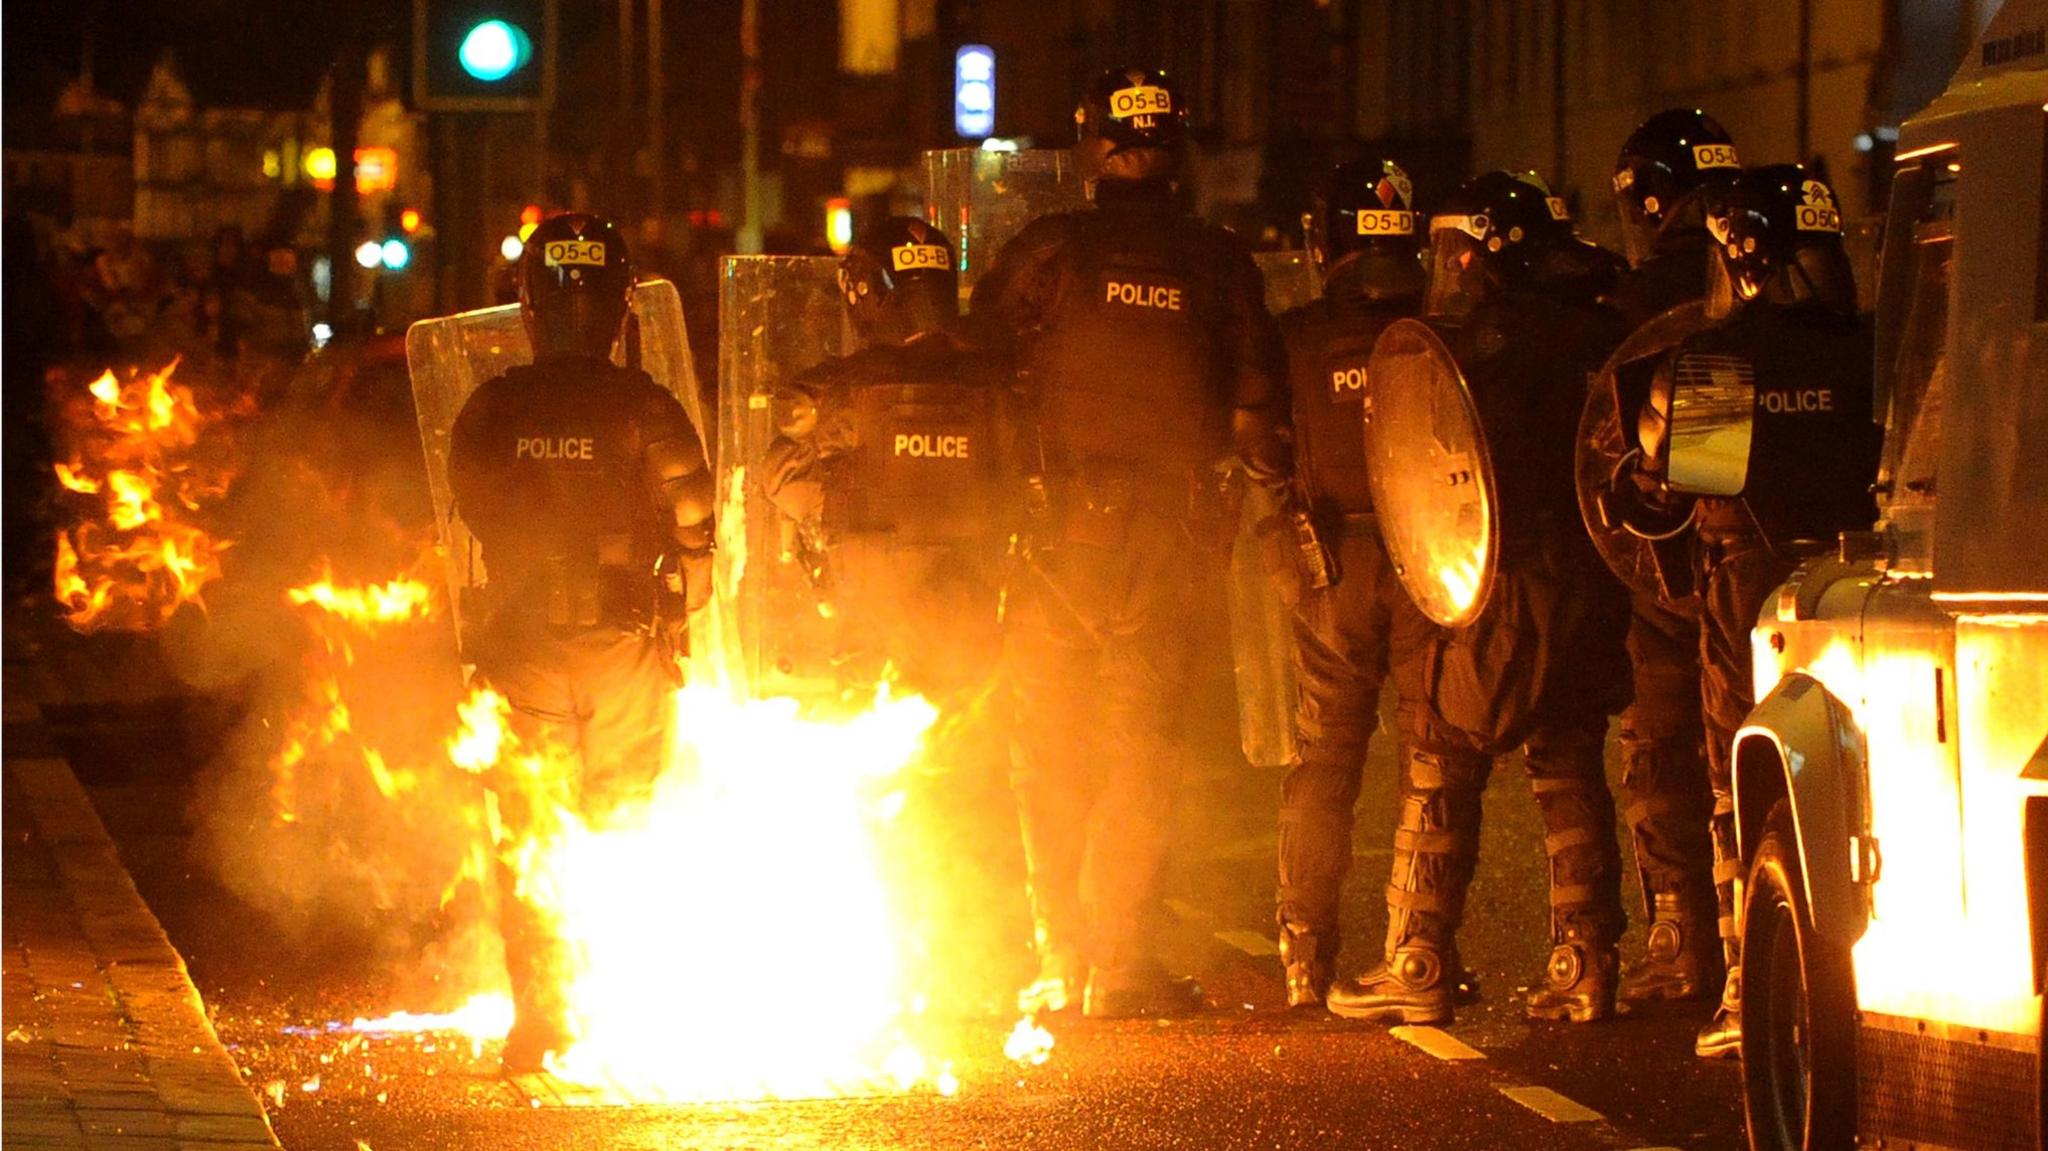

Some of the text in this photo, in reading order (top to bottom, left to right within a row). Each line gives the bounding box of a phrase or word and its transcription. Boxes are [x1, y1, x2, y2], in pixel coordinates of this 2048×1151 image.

[1117, 90, 1170, 111] O5-B
[1362, 212, 1411, 231] O5-D
[550, 243, 602, 262] O5-C
[899, 247, 948, 266] O5-B
[1106, 281, 1181, 311] POLICE
[516, 437, 594, 460] POLICE
[894, 434, 969, 458] POLICE
